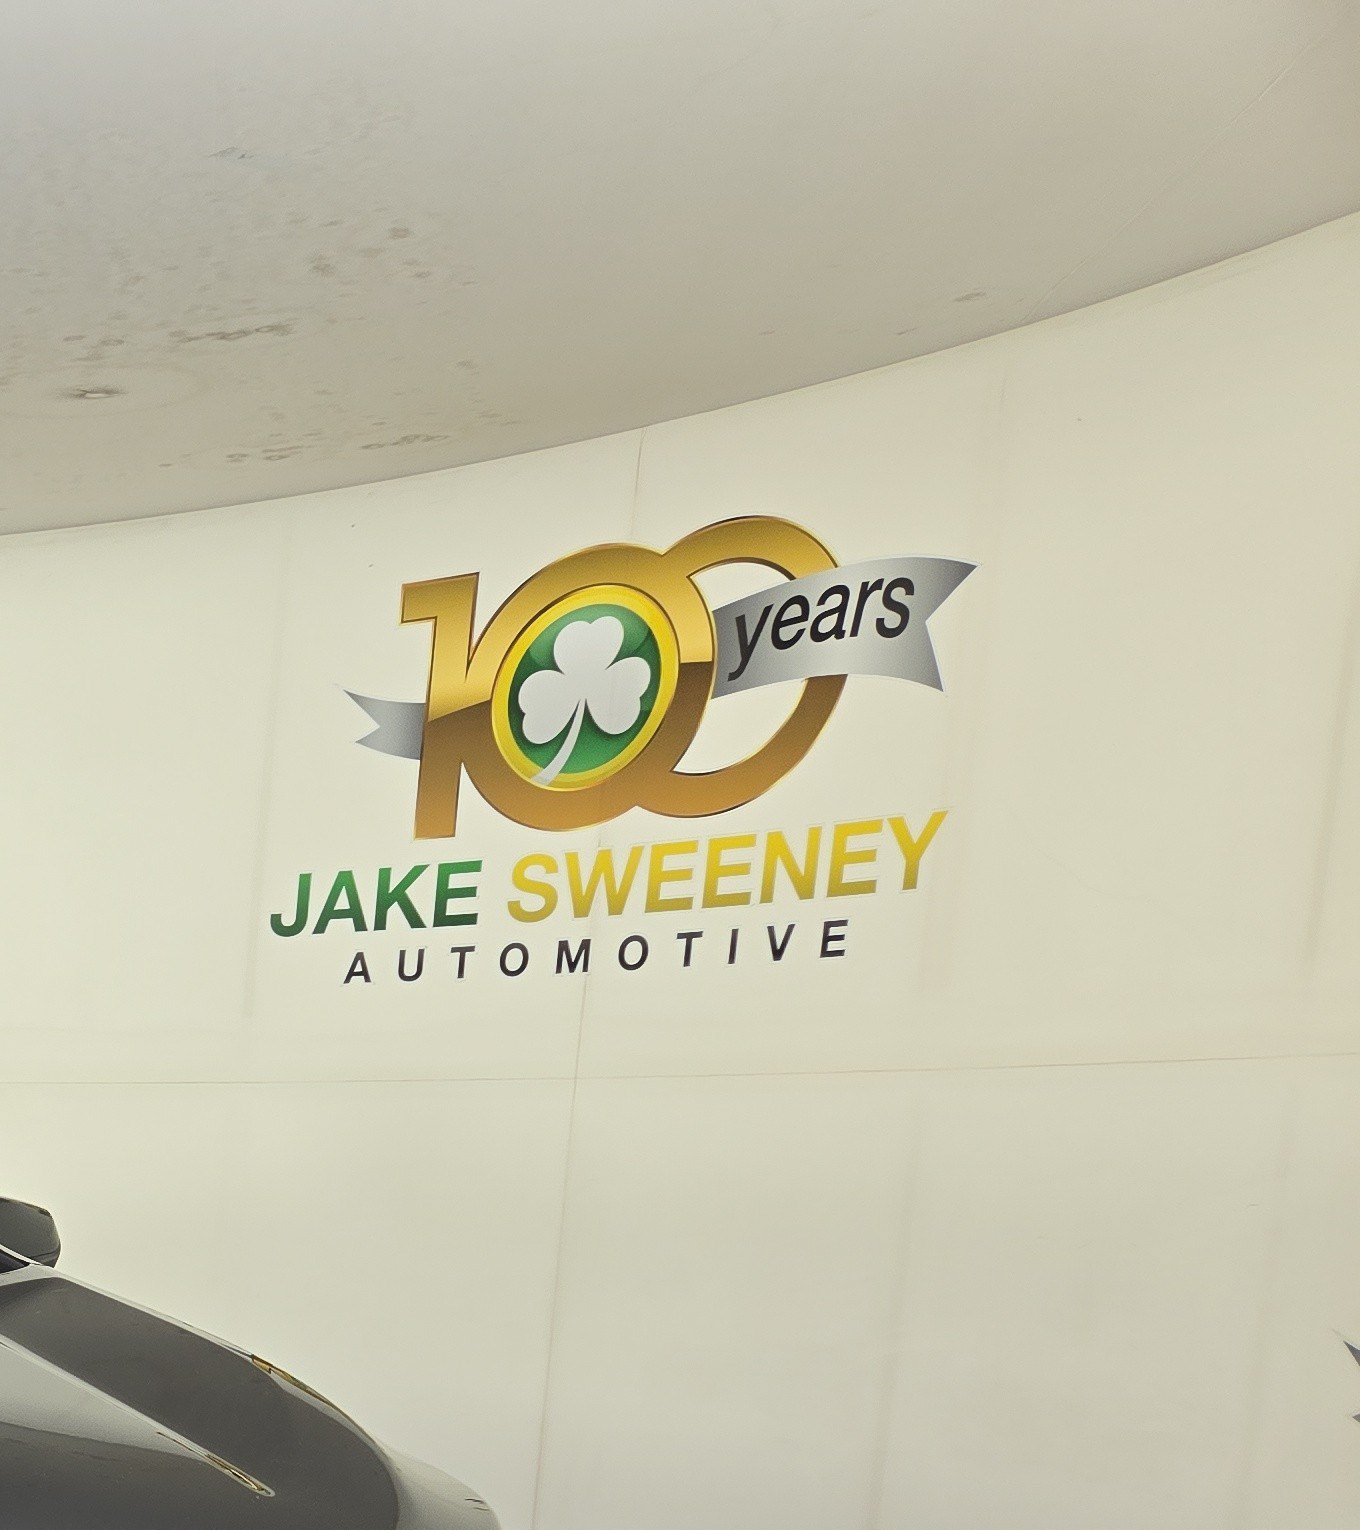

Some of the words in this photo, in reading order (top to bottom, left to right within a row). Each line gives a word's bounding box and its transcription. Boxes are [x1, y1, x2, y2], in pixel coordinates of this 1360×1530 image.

[727, 574, 914, 682] years
[270, 860, 482, 937] JAKE
[507, 811, 947, 922] SWEENEY
[343, 919, 850, 984] AUTOMOTIVE
